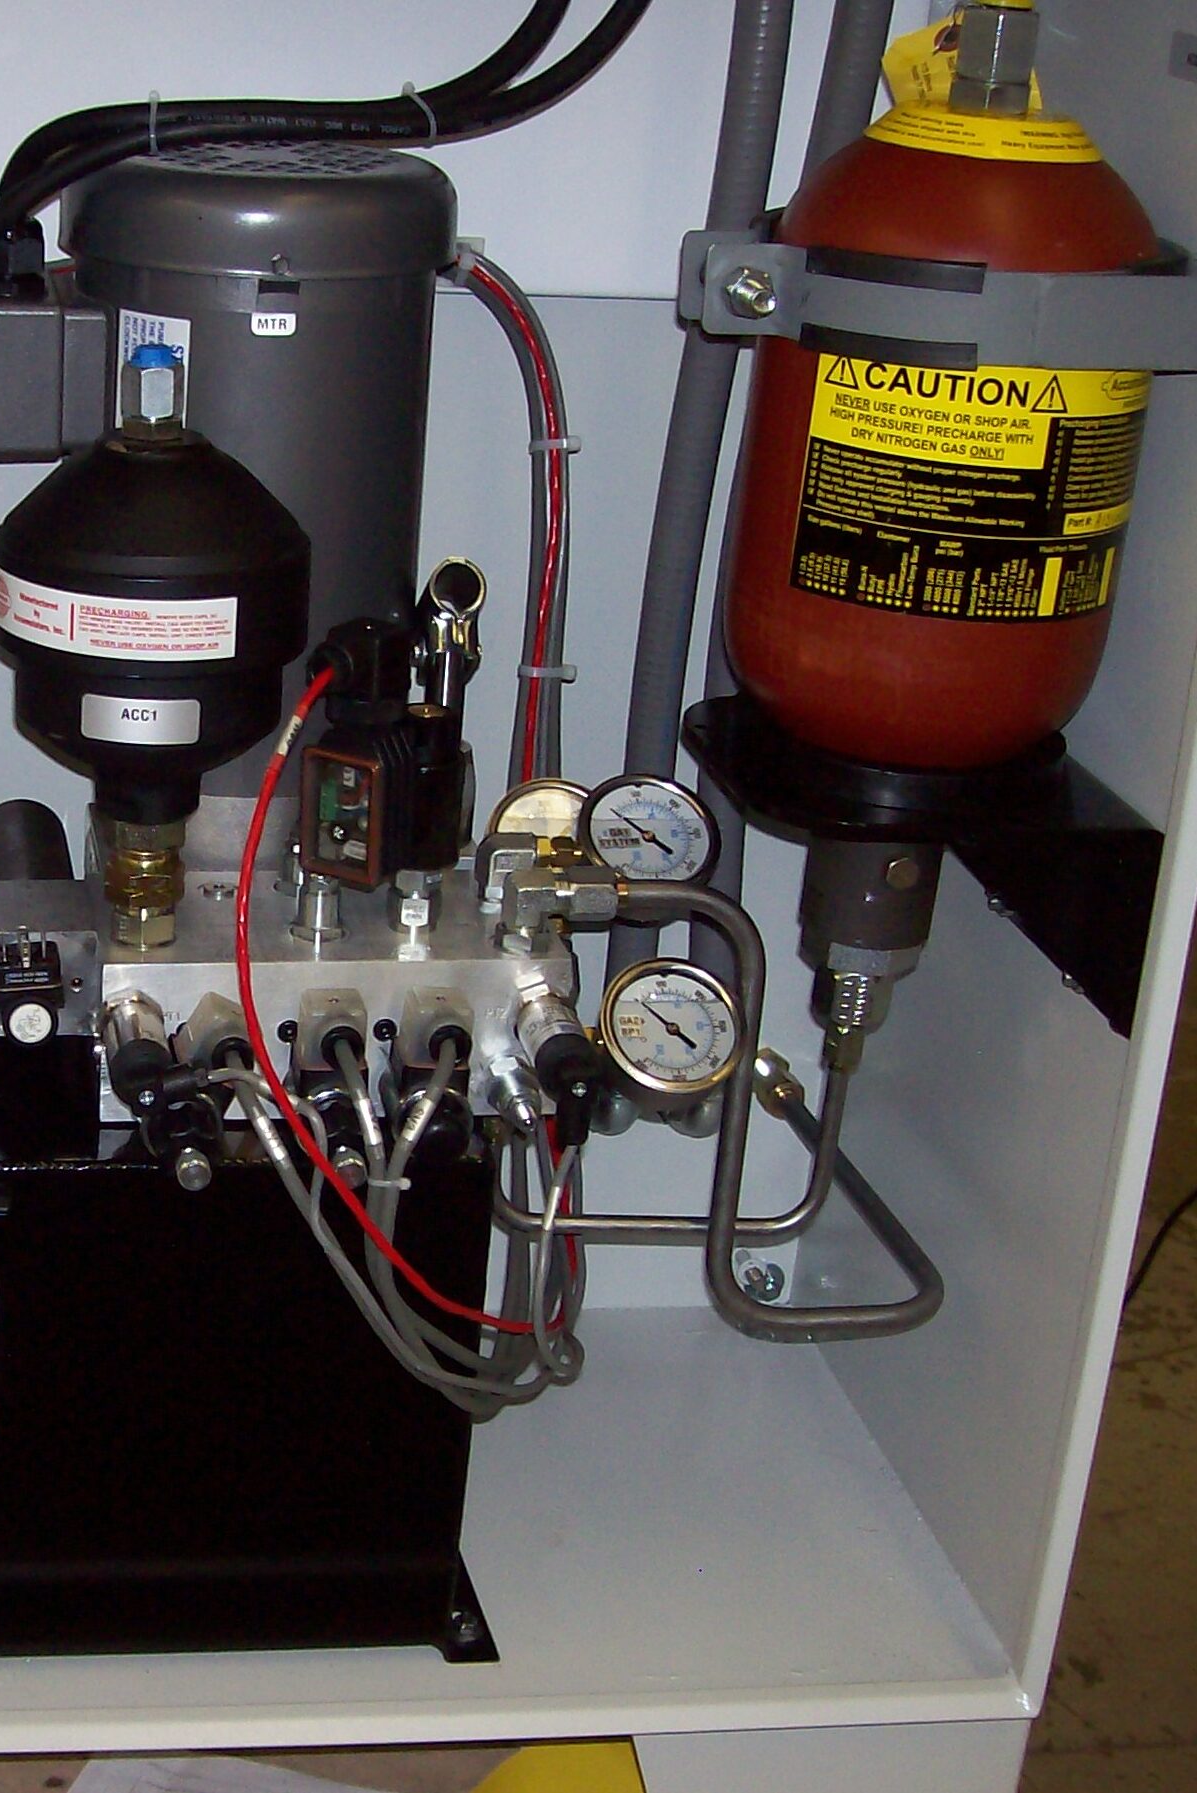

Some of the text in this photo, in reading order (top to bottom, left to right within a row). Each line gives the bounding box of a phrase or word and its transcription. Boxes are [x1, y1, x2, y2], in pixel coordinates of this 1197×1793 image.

[257, 318, 287, 330] MTR
[865, 362, 1030, 407] CAUTION
[830, 407, 1034, 445] HIGH PRESSURE! PRECHARGE WITH
[835, 393, 1031, 429] NEVER USE OXYGEN OR SHOP AIR.
[851, 427, 1004, 460] DRY NITROGEN GAS ONLY!
[121, 708, 158, 722] ACC1
